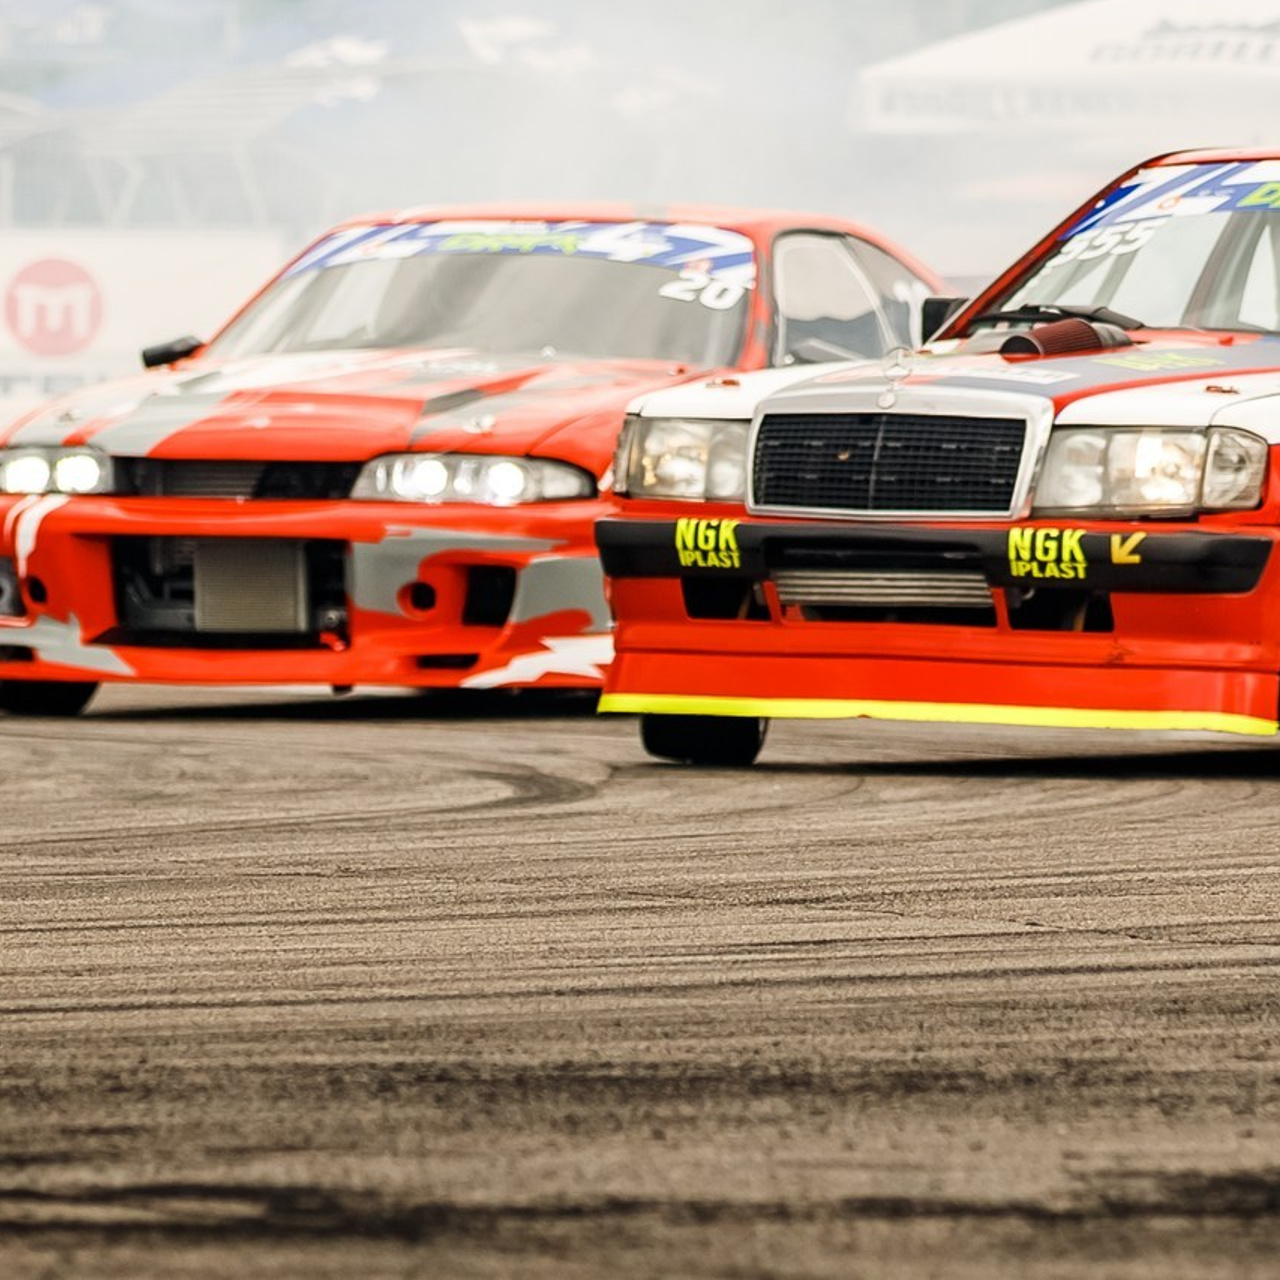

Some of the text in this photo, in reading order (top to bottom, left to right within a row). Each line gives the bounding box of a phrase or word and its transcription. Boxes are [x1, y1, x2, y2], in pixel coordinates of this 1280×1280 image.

[658, 270, 746, 311] 20
[675, 517, 741, 551] NGK
[1008, 527, 1087, 563] NGK
